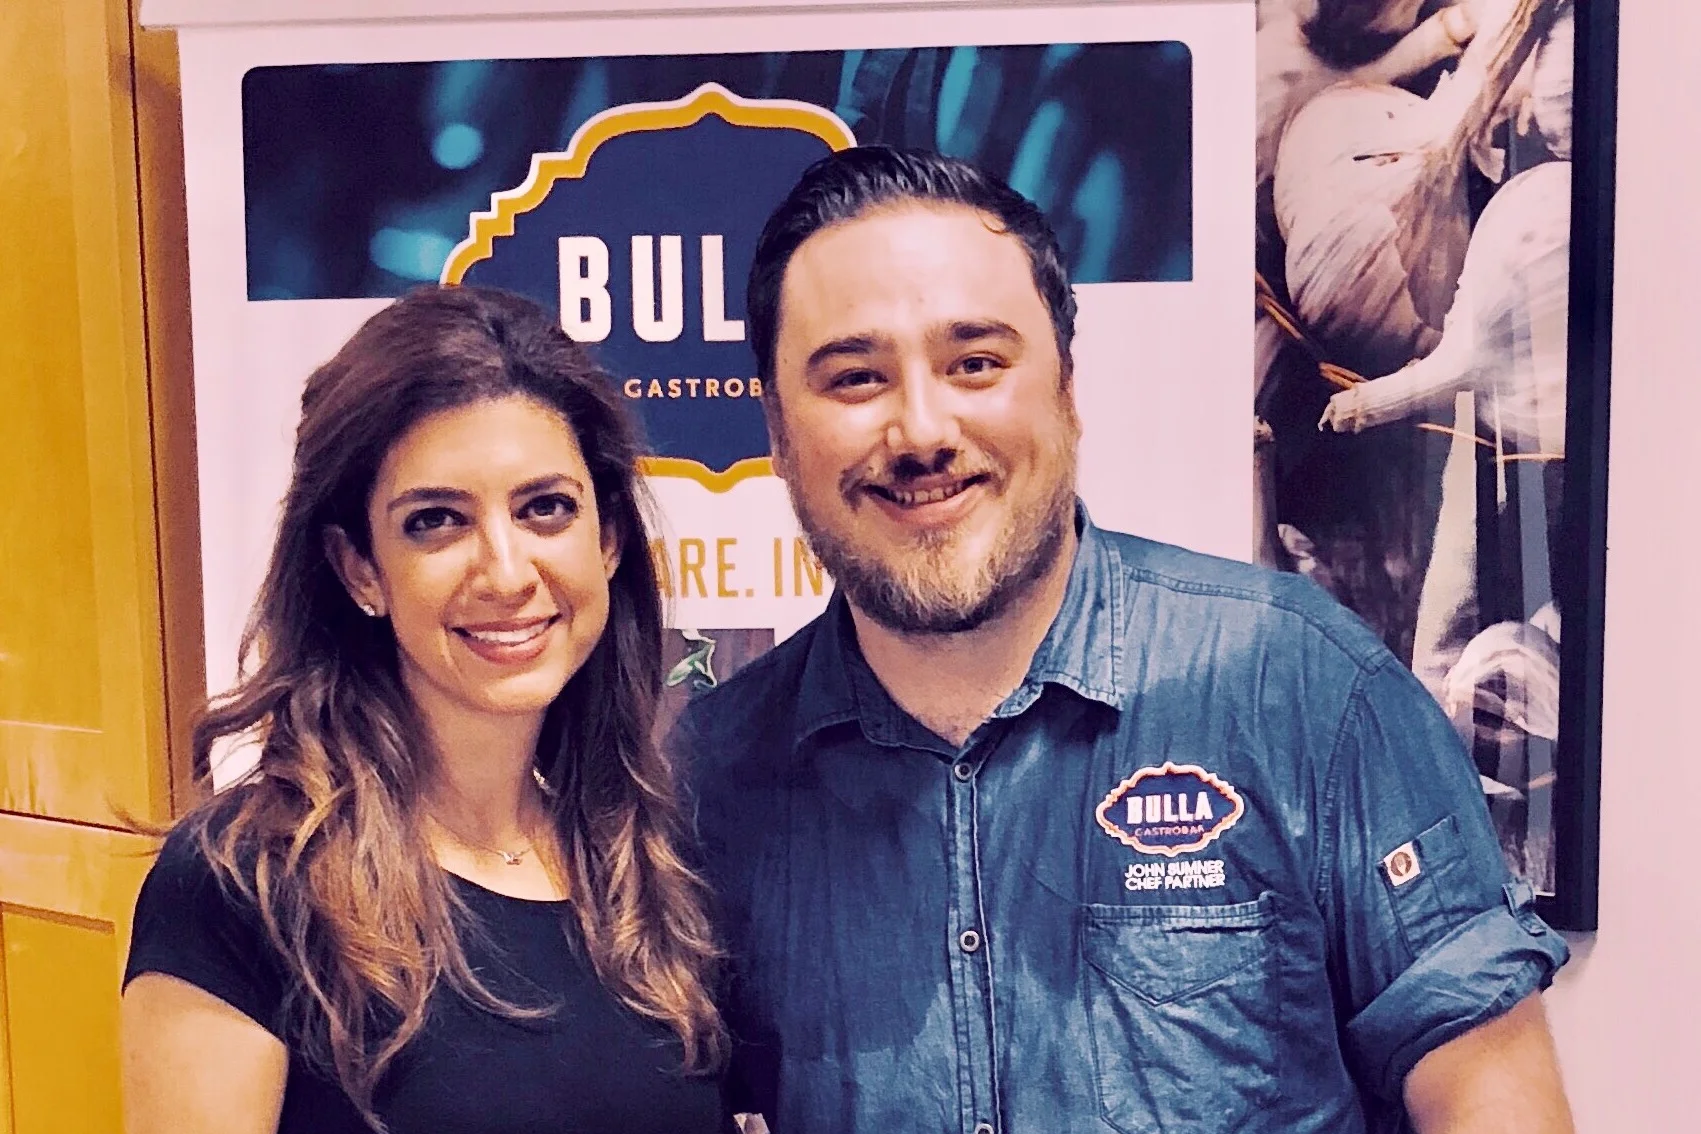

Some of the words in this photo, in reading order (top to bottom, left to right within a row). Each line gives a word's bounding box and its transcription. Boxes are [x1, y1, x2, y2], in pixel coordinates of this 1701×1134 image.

[1126, 791, 1213, 824] BULLA
[1134, 825, 1205, 837] GASTROBAR
[1124, 863, 1166, 878] JOHN
[1167, 860, 1225, 876] SUMNER
[1125, 876, 1162, 890] CHEF
[1164, 874, 1226, 890] PARTNER
